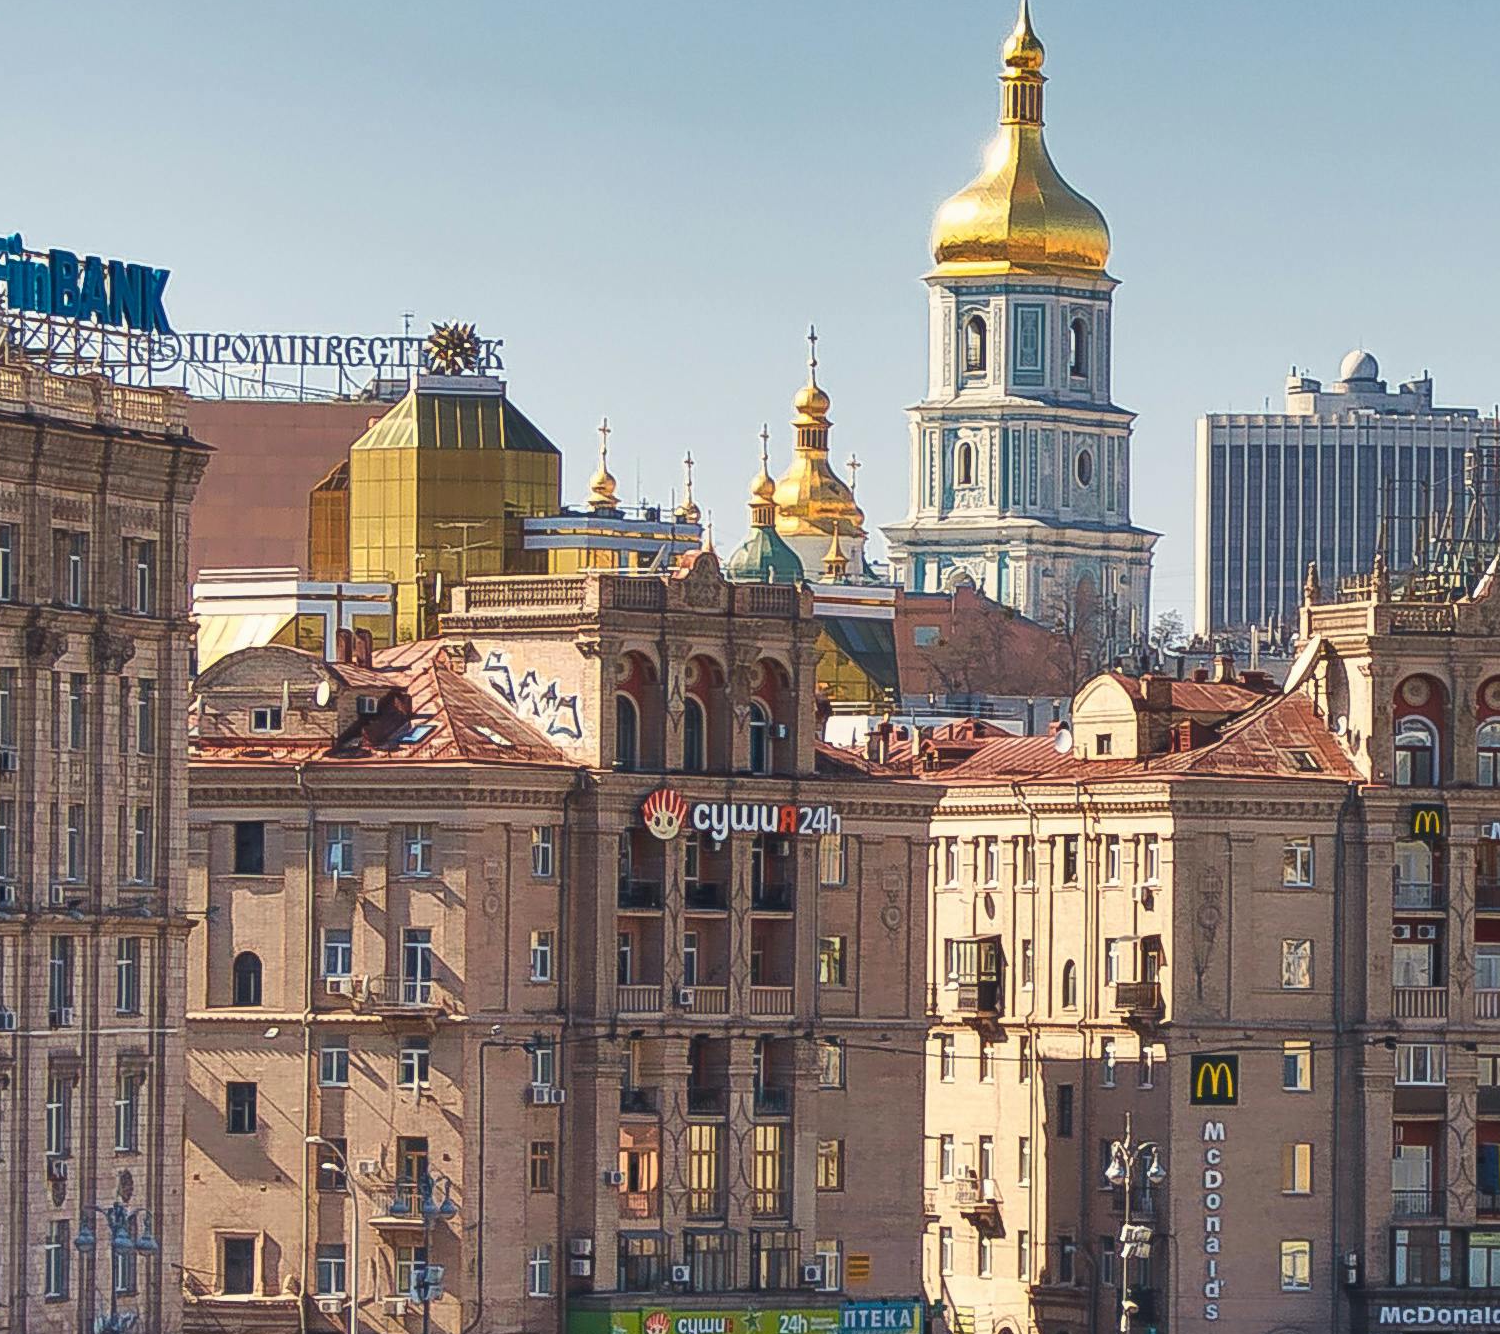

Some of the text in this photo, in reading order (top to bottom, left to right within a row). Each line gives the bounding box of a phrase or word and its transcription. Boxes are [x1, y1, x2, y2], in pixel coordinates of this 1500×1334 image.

[186, 333, 505, 370] ПРОМІНВЕСТК
[799, 805, 841, 835] 24h
[1202, 1121, 1229, 1322] McDonald's
[779, 1314, 808, 1334] 24h
[843, 1309, 913, 1328] ПТЕКА
